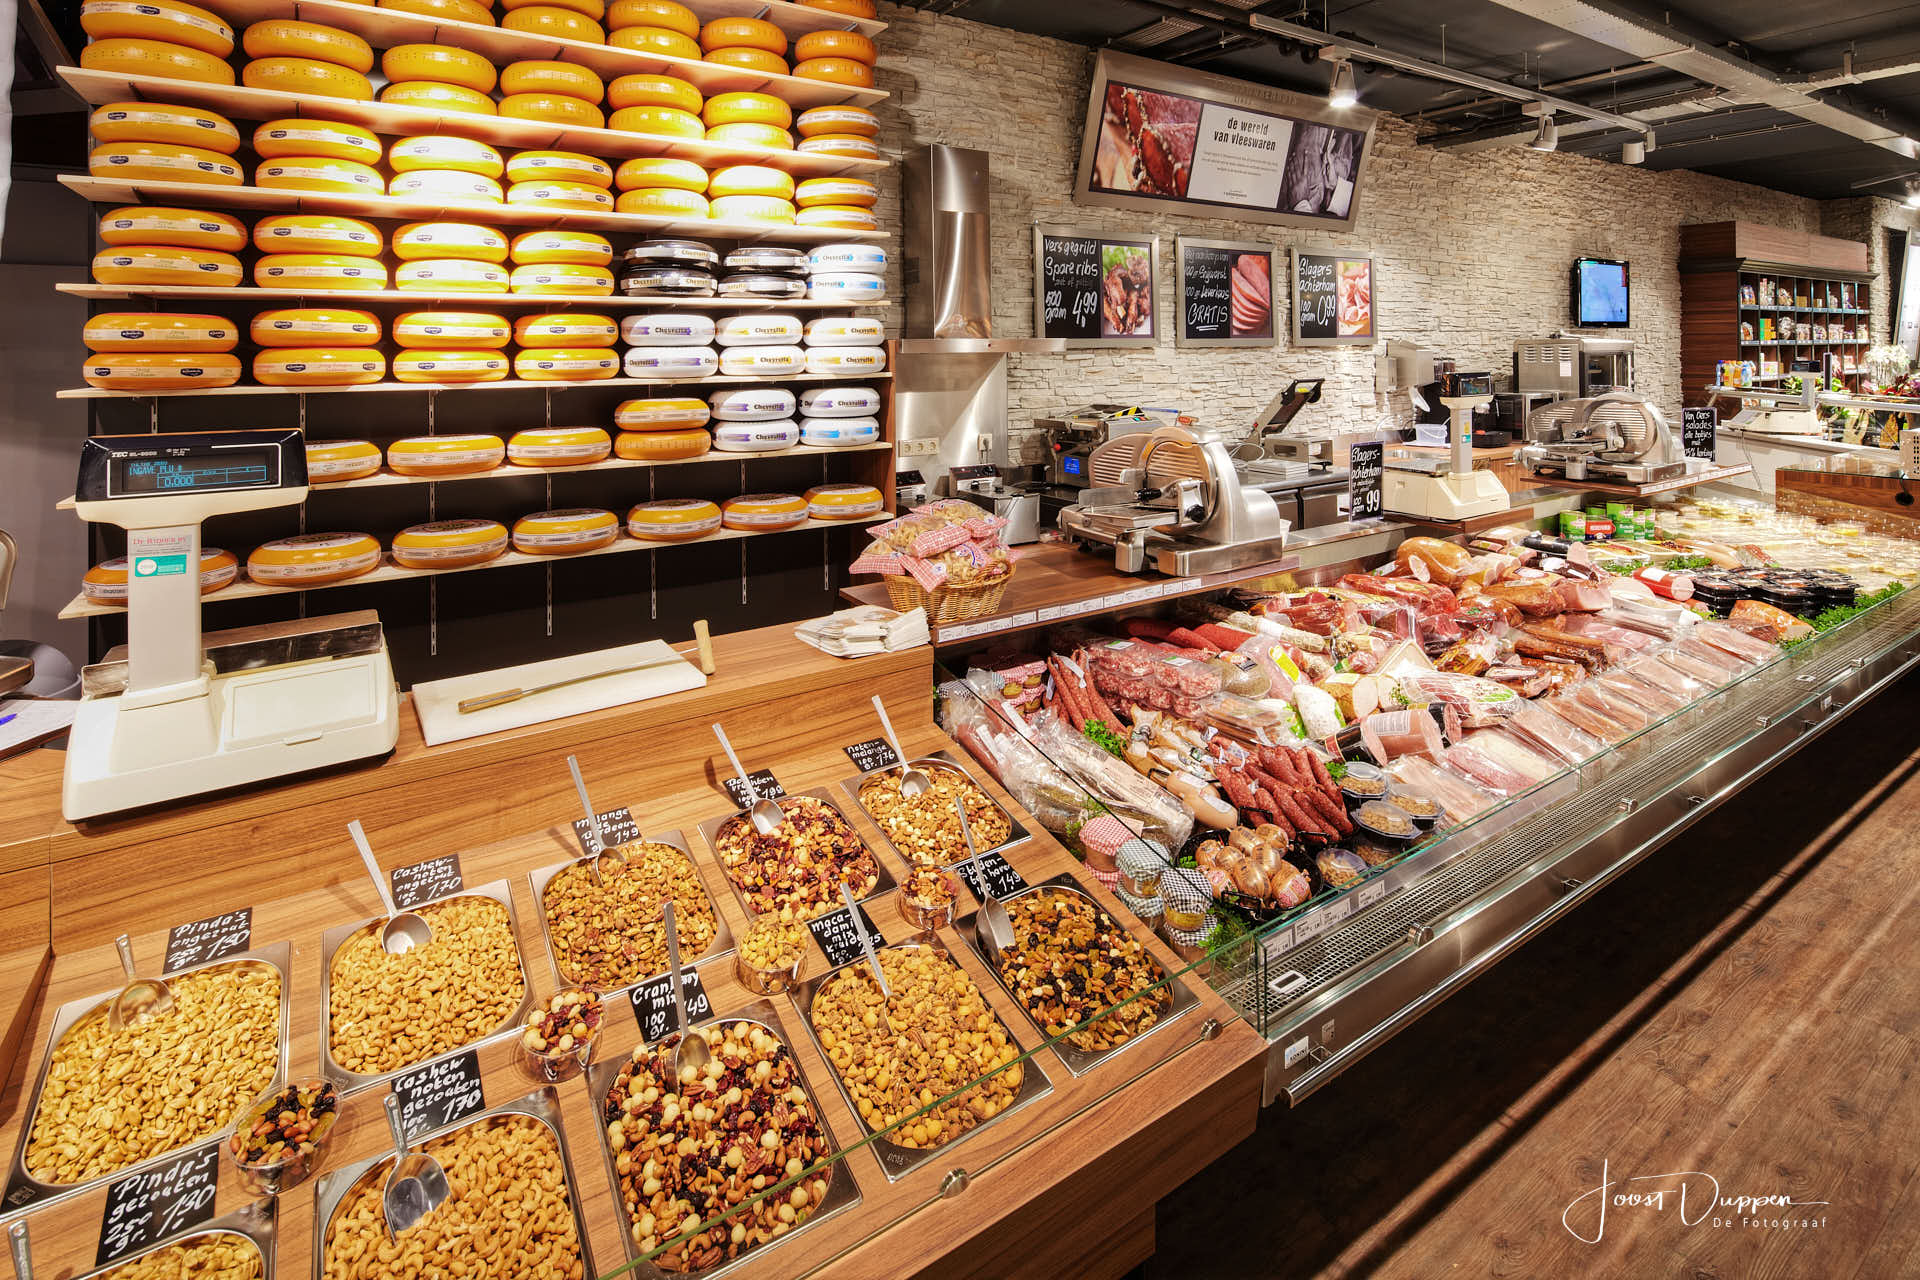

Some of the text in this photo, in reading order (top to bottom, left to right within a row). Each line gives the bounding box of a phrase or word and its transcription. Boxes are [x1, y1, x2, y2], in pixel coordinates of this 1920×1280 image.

[1227, 117, 1269, 136] de wereld
[1214, 130, 1276, 151] van vleeswaren
[1188, 302, 1228, 325] GRATIS
[1367, 489, 1380, 513] 99
[645, 1011, 666, 1029] 100
[395, 1057, 466, 1093] Cashew
[411, 1071, 466, 1099] noten
[114, 1150, 218, 1201] Pinda's
[103, 1211, 153, 1245] 250
